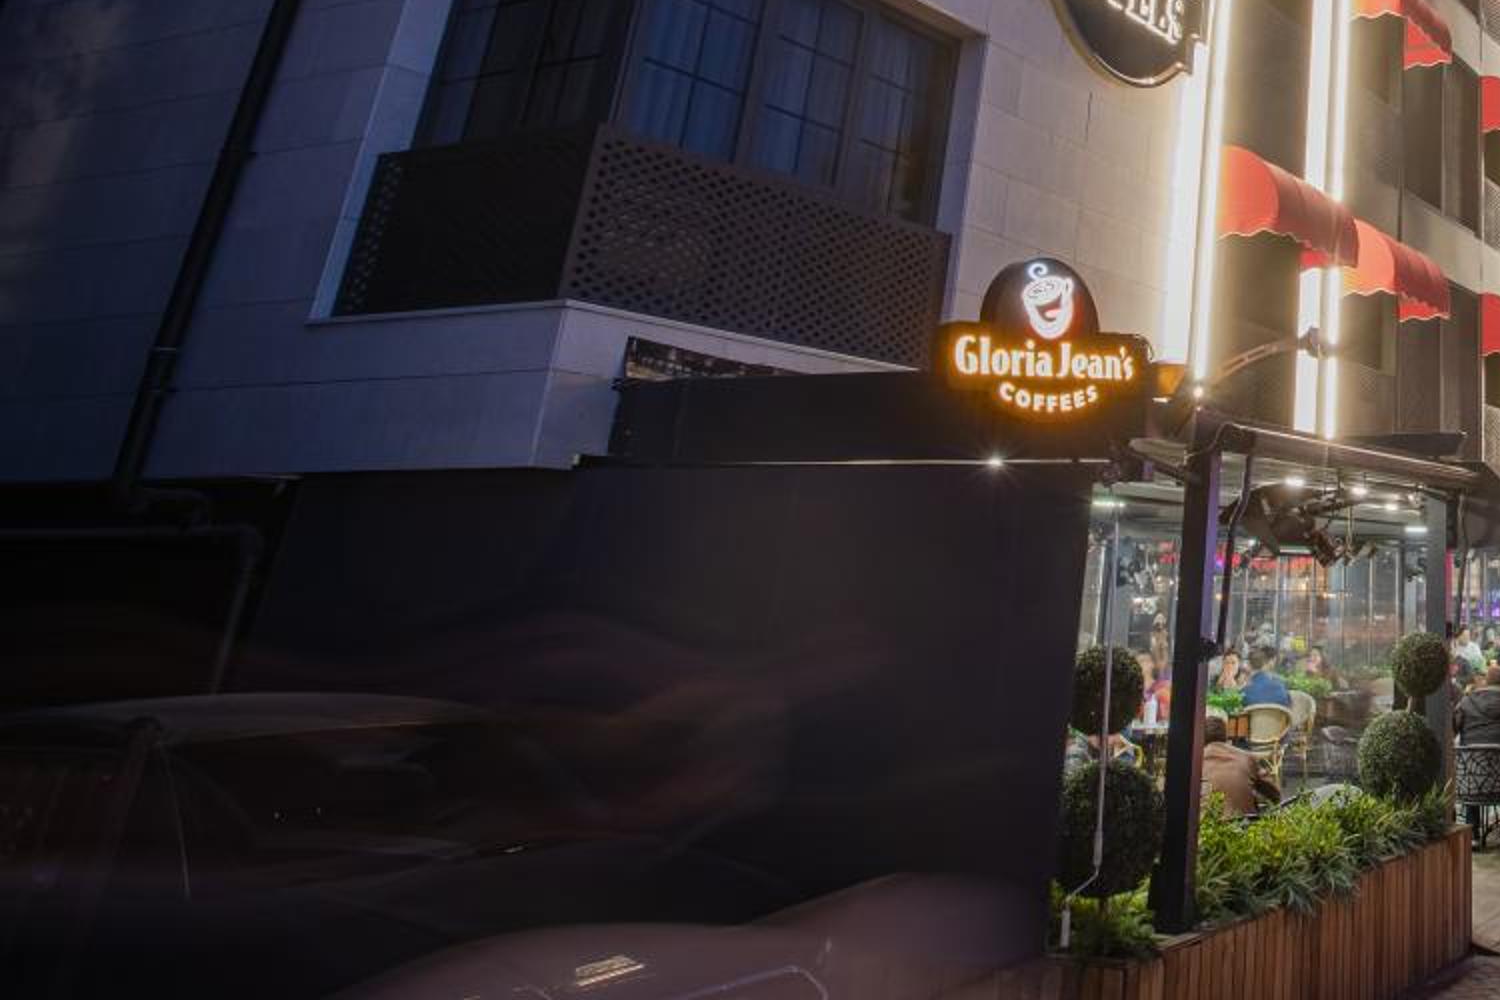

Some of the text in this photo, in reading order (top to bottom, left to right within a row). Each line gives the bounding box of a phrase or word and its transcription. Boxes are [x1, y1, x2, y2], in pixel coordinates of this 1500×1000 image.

[954, 335, 1135, 381] Gloria Jean's
[999, 382, 1098, 413] COFFEES
